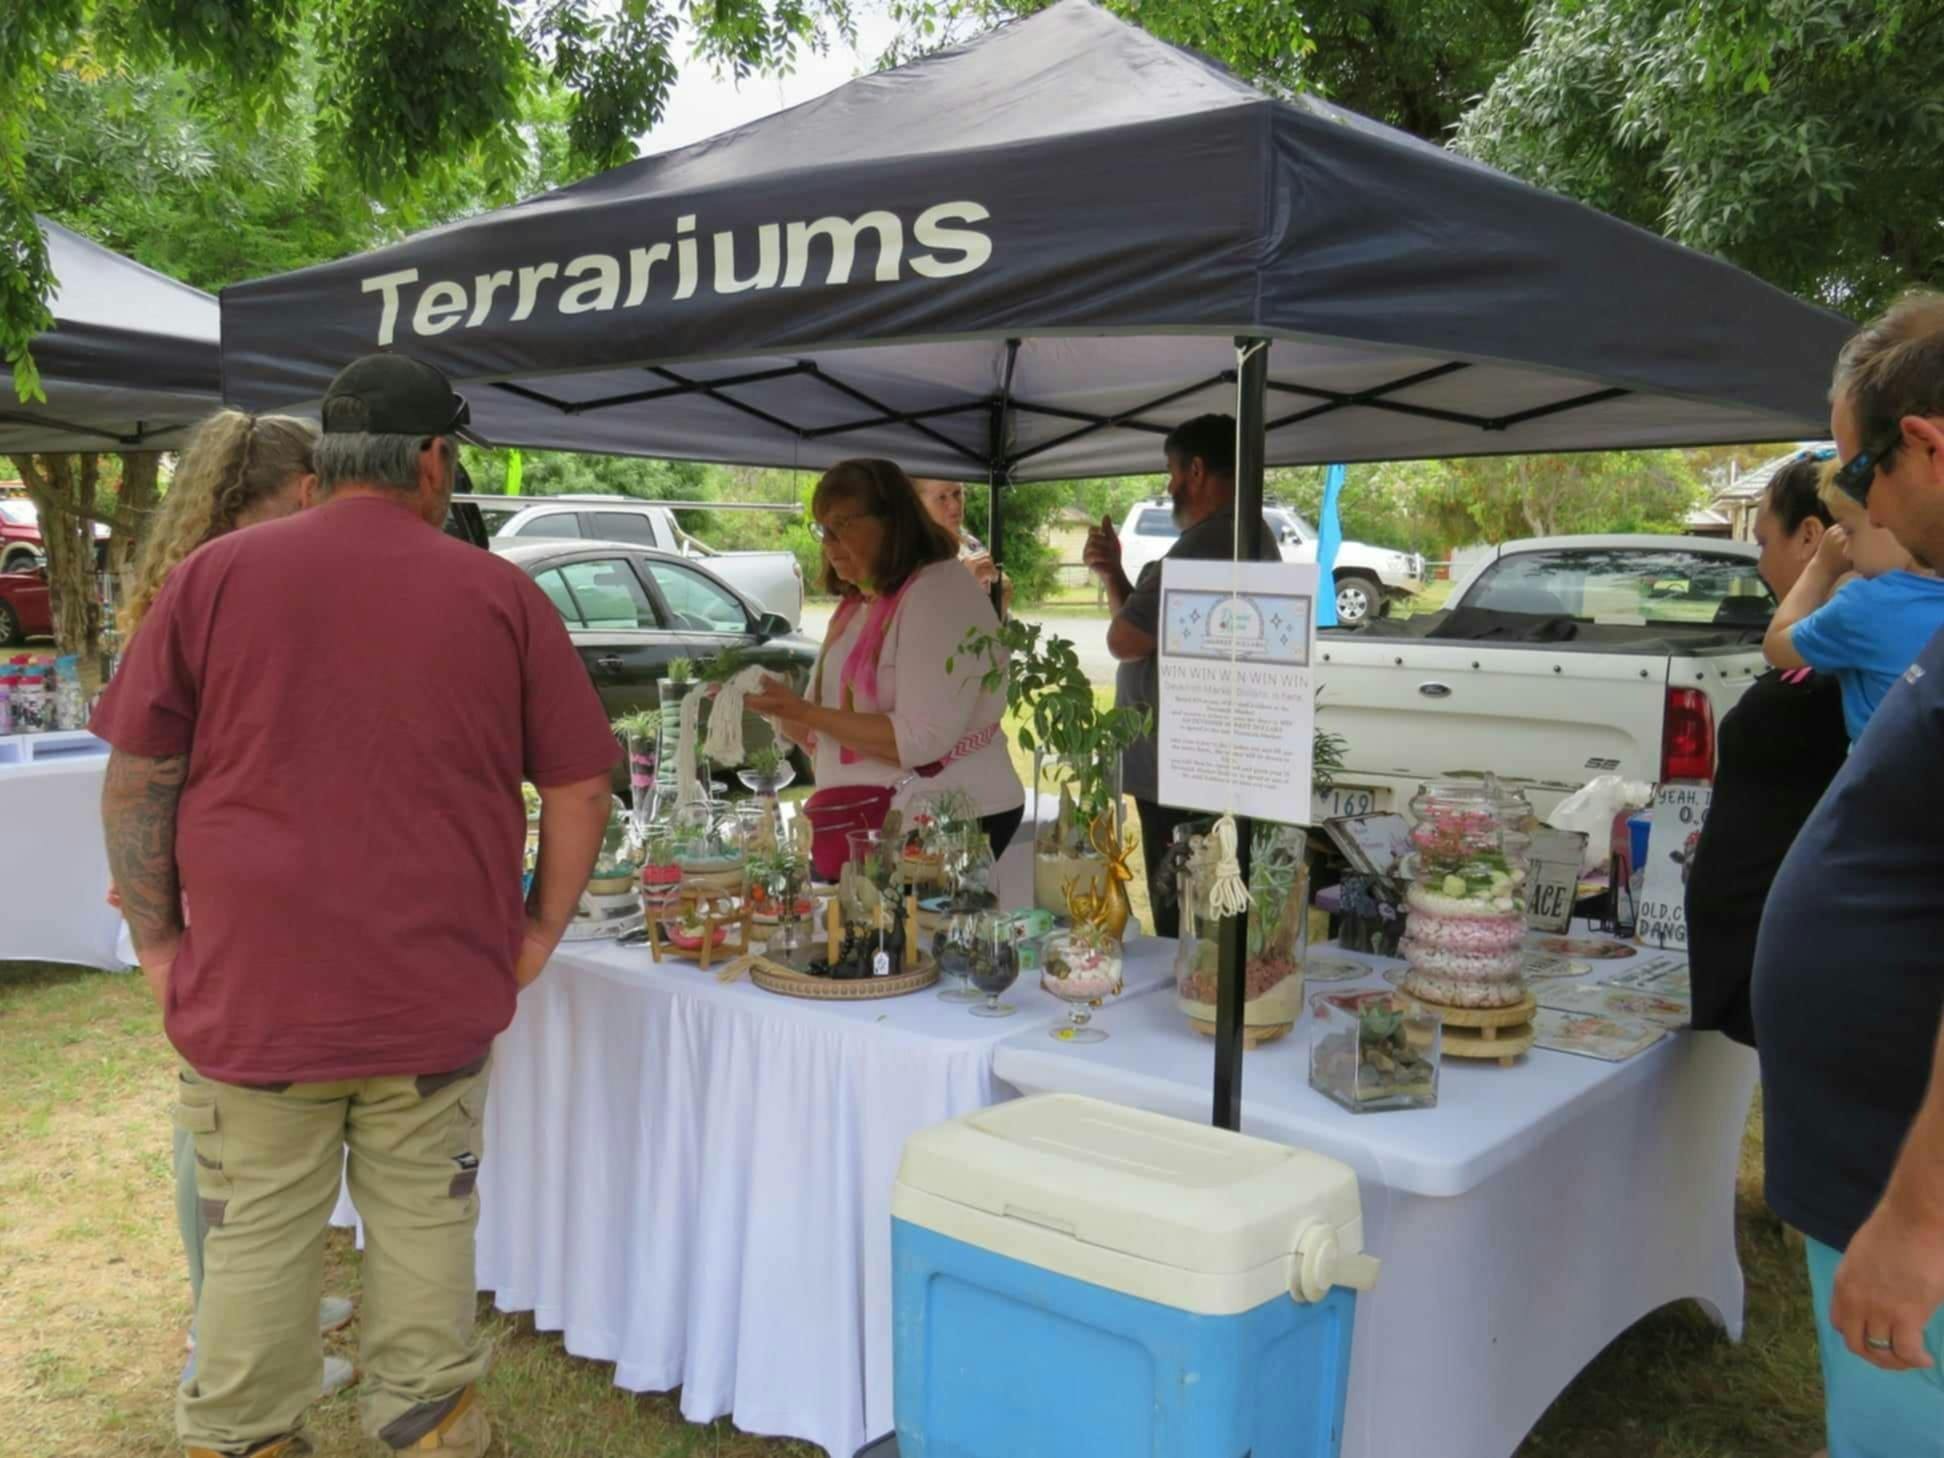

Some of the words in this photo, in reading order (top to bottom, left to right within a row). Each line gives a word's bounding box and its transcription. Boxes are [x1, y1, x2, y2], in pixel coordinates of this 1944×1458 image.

[361, 200, 993, 346] Terrariums
[1161, 664, 1186, 678] WIN
[1190, 667, 1216, 680] WIN
[1219, 669, 1246, 683] WN
[1250, 672, 1277, 685] WIN
[1280, 674, 1309, 689] WIN
[1333, 791, 1369, 817] 169
